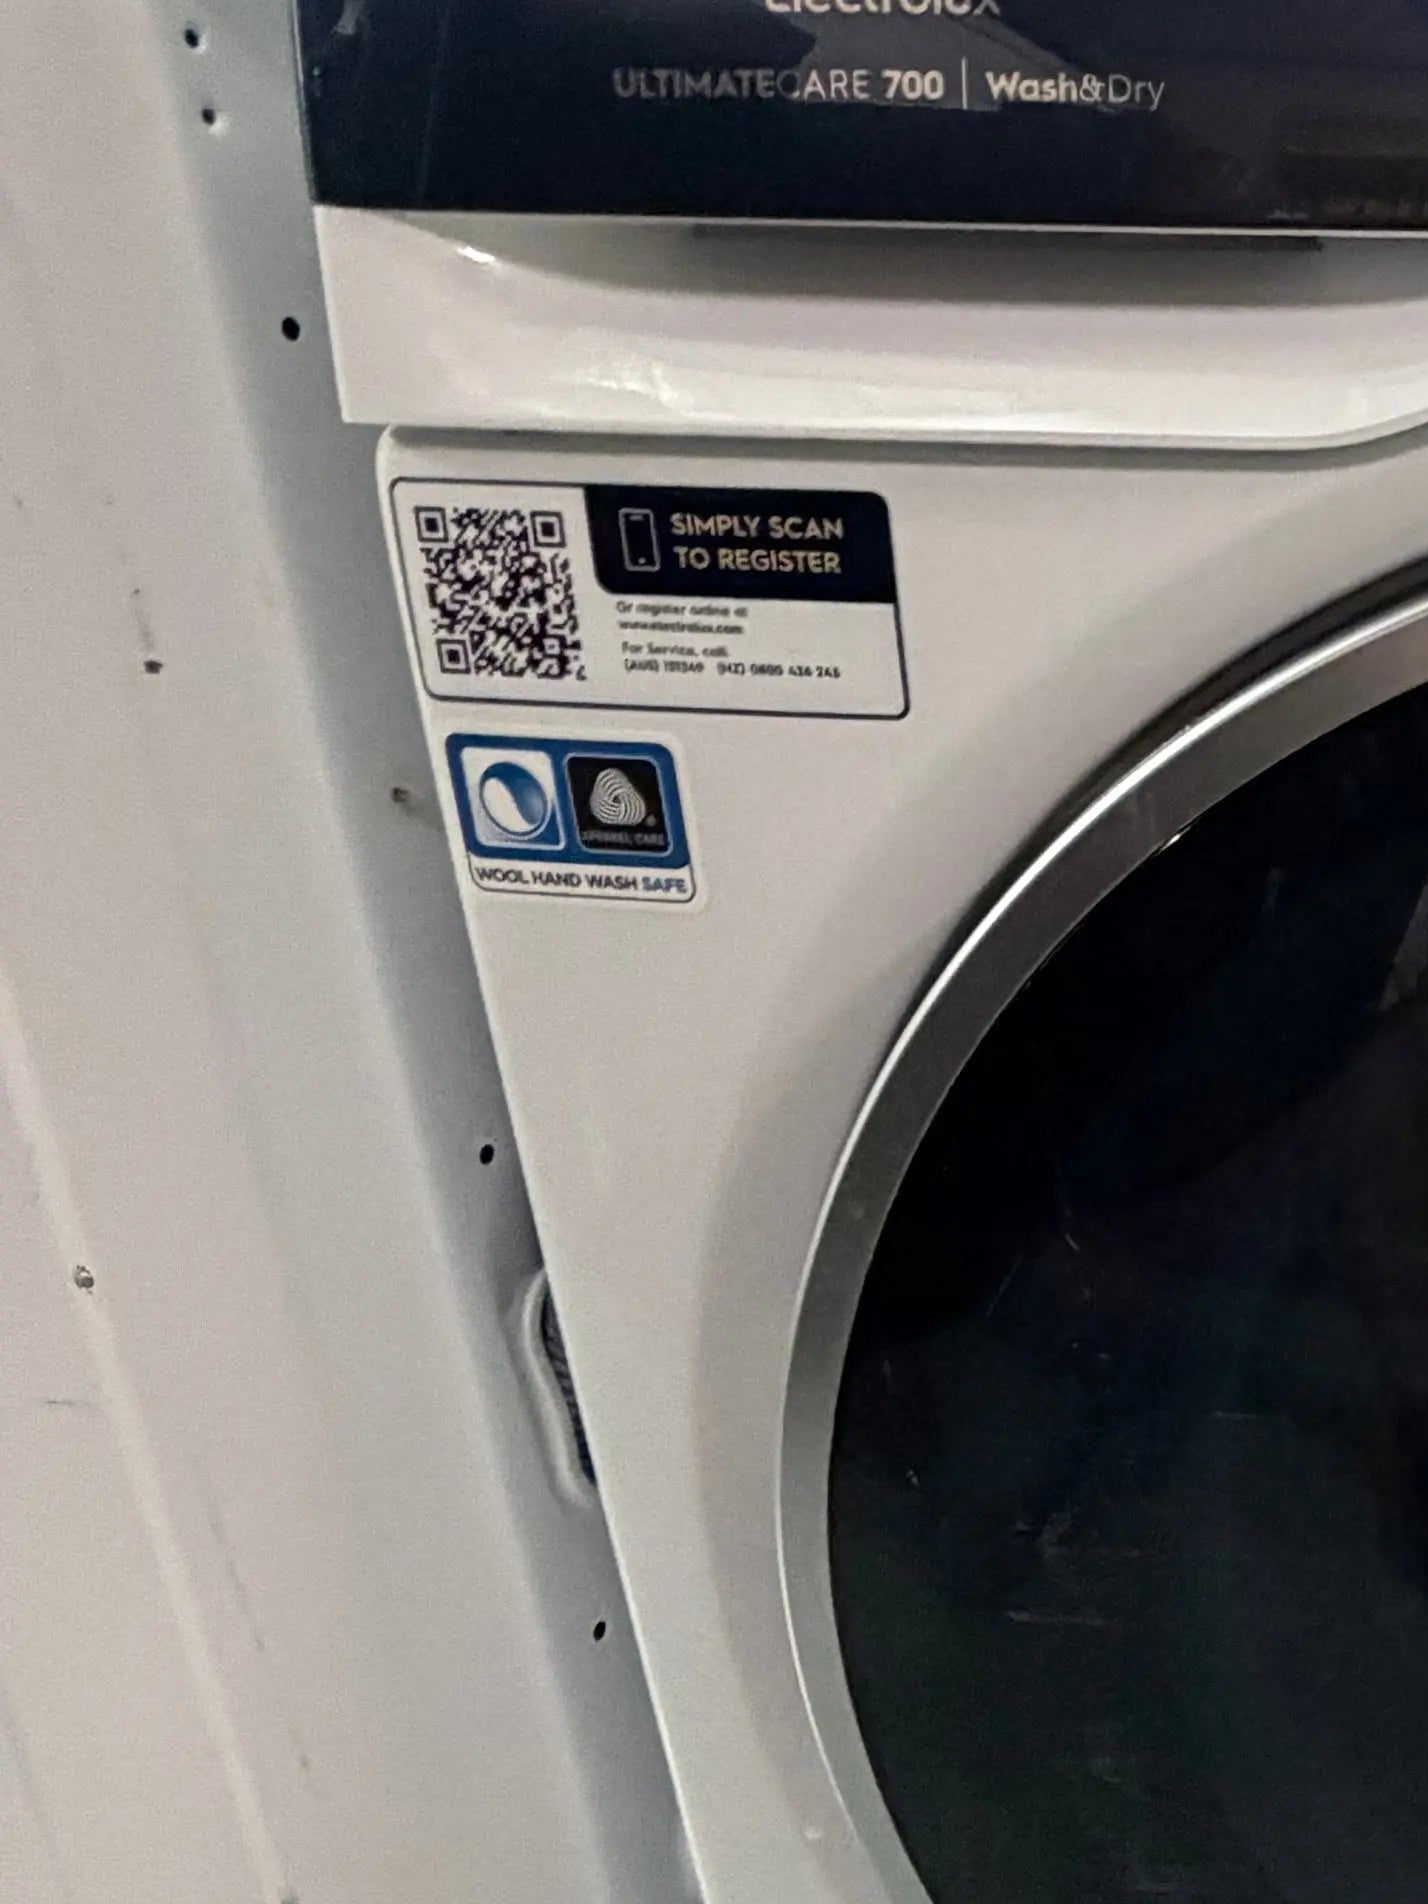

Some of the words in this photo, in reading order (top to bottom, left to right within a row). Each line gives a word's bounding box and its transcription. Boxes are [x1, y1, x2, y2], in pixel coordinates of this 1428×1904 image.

[612, 66, 870, 100] ULTIMATECARE
[881, 68, 945, 101] 700
[984, 69, 1165, 111] Wash&Dry
[669, 512, 761, 539] SIMPLY
[768, 515, 844, 540] SCAN
[672, 546, 711, 570] TO
[718, 547, 842, 574] REGISTER
[621, 640, 643, 654] For
[475, 866, 529, 885] WOOL
[531, 870, 583, 888] HAND
[585, 873, 638, 891] WASH
[641, 876, 688, 894] SAFE
